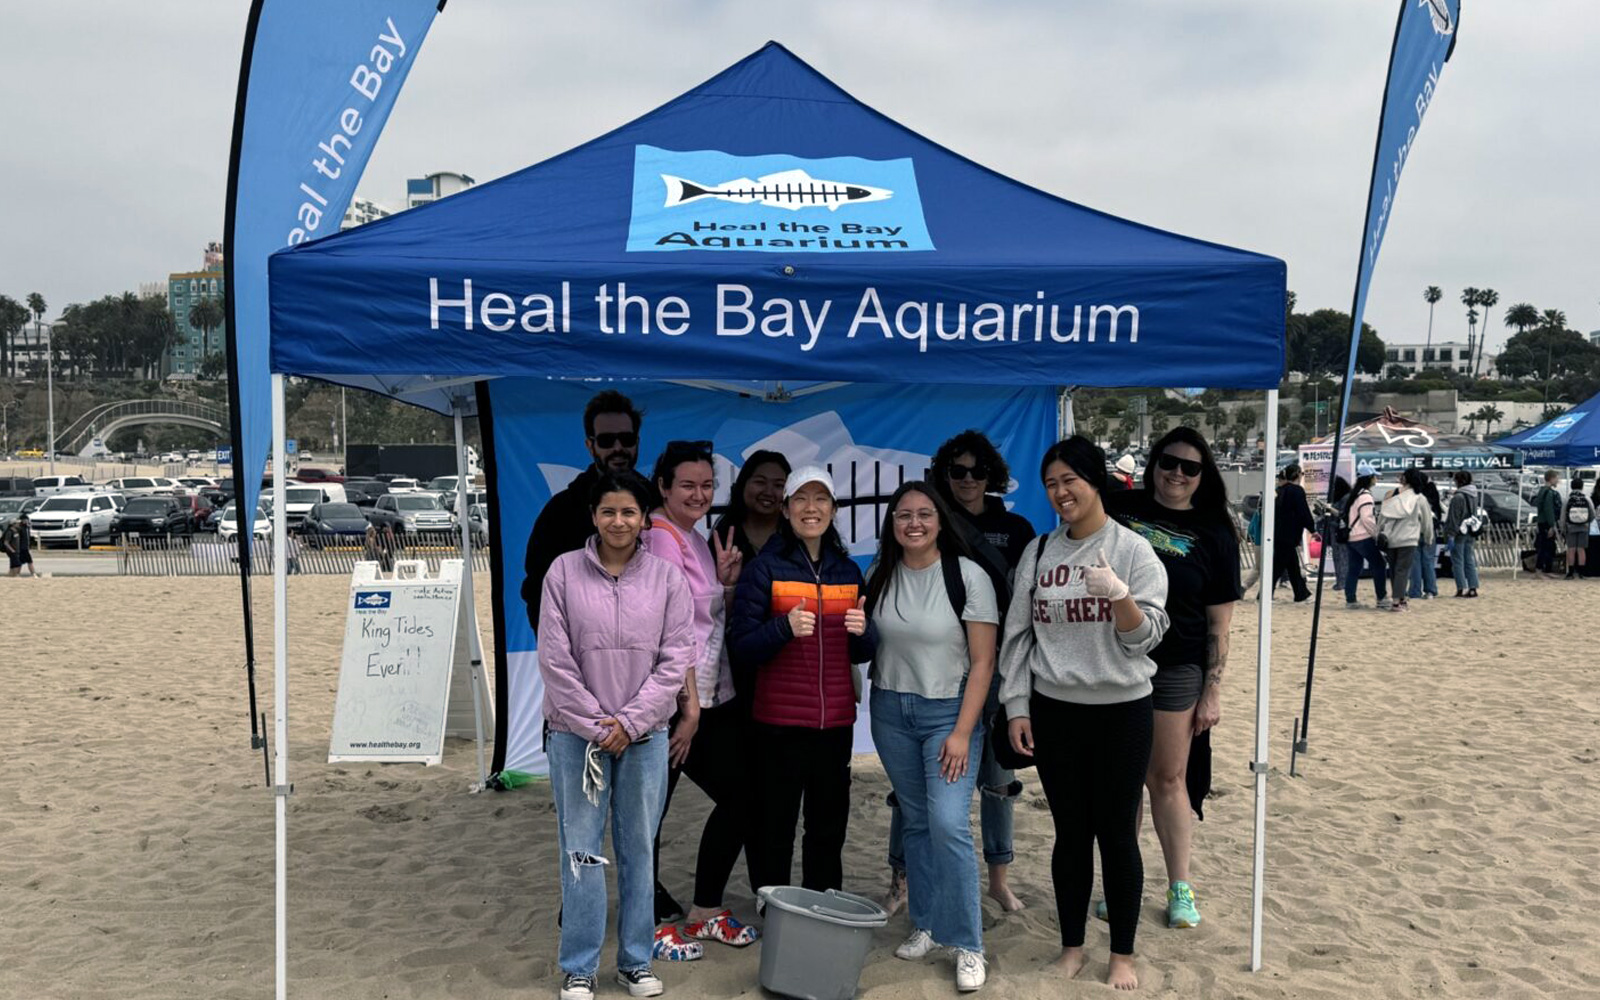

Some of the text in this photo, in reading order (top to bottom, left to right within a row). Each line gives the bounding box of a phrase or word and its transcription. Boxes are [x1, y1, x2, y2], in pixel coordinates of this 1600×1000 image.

[312, 107, 363, 180] the
[350, 16, 407, 102] Bay
[1393, 126, 1416, 182] the
[654, 231, 909, 249] Aquarium
[693, 221, 903, 236] Heal the Bay
[428, 277, 1140, 353] Heal the Bay Aquarium
[1431, 456, 1512, 468] FESTIVAL
[361, 615, 434, 648] King Tides
[349, 741, 421, 749] www.healthebay.org
